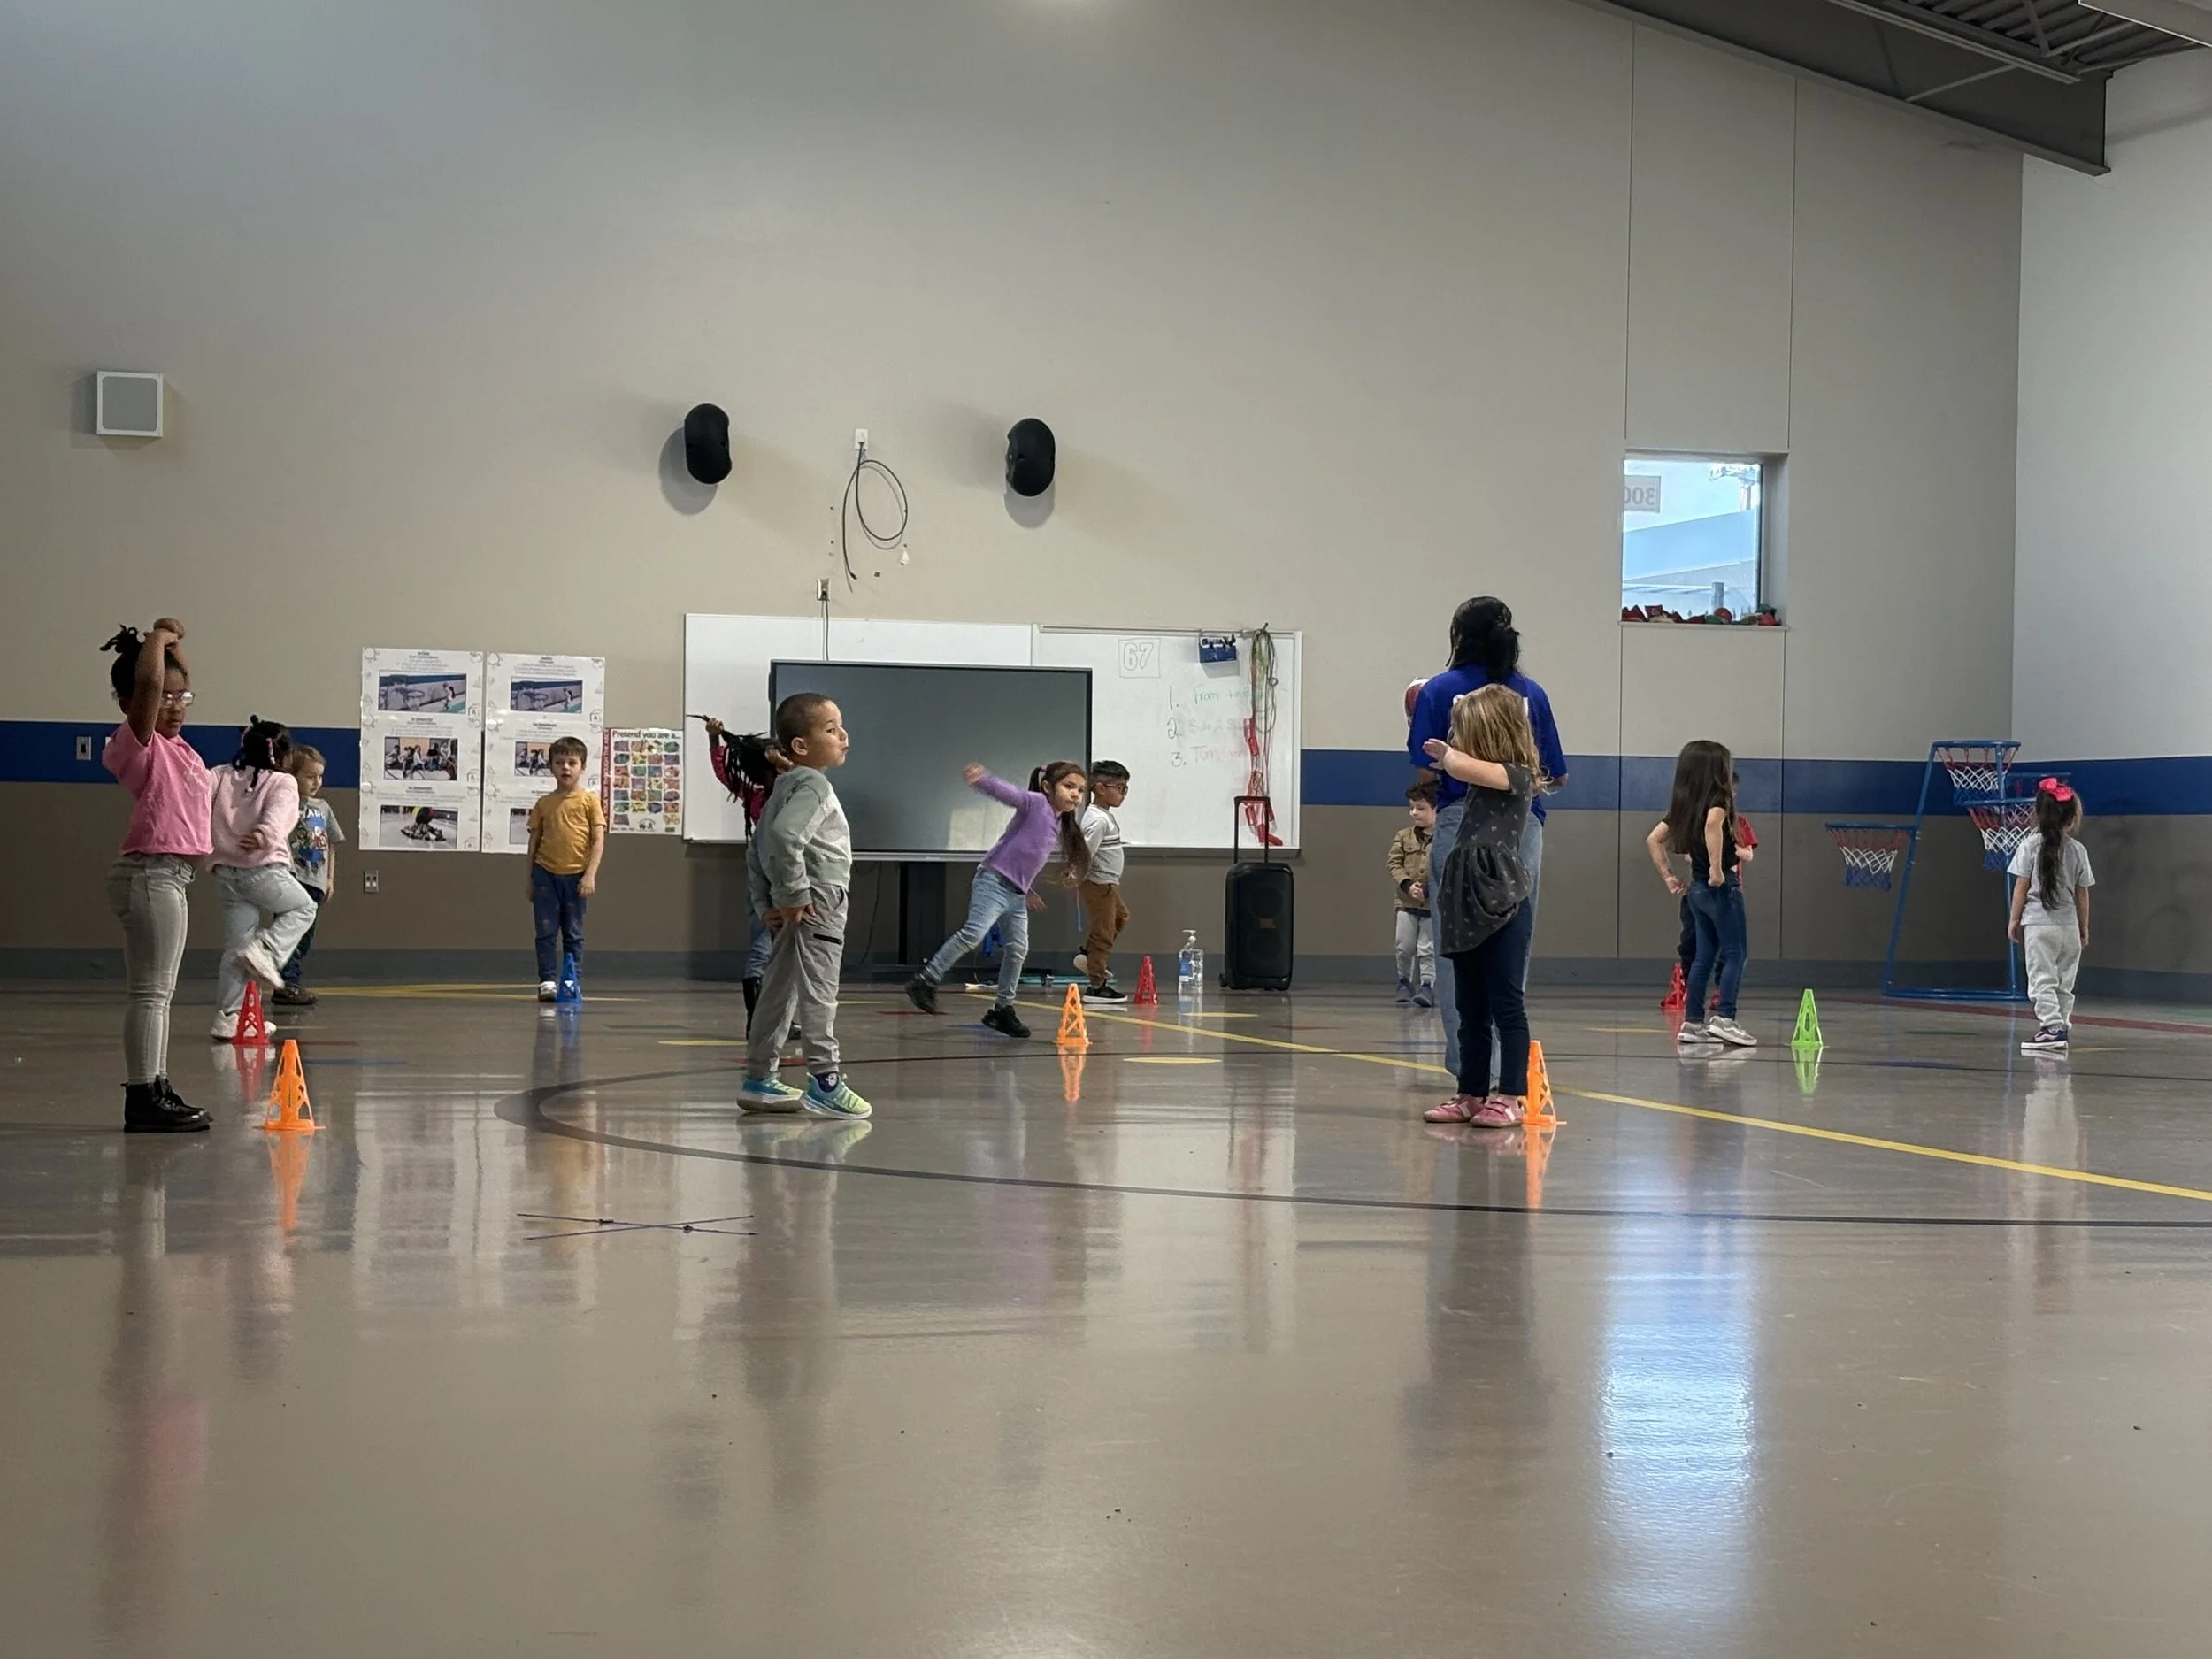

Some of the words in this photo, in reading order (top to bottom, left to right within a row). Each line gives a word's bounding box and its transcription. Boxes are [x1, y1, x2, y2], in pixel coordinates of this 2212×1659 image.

[1123, 641, 1154, 671] 67
[1169, 685, 1179, 710] 1.
[612, 730, 641, 739] Pretend
[642, 731, 656, 740] you
[1171, 751, 1187, 767] 3.
